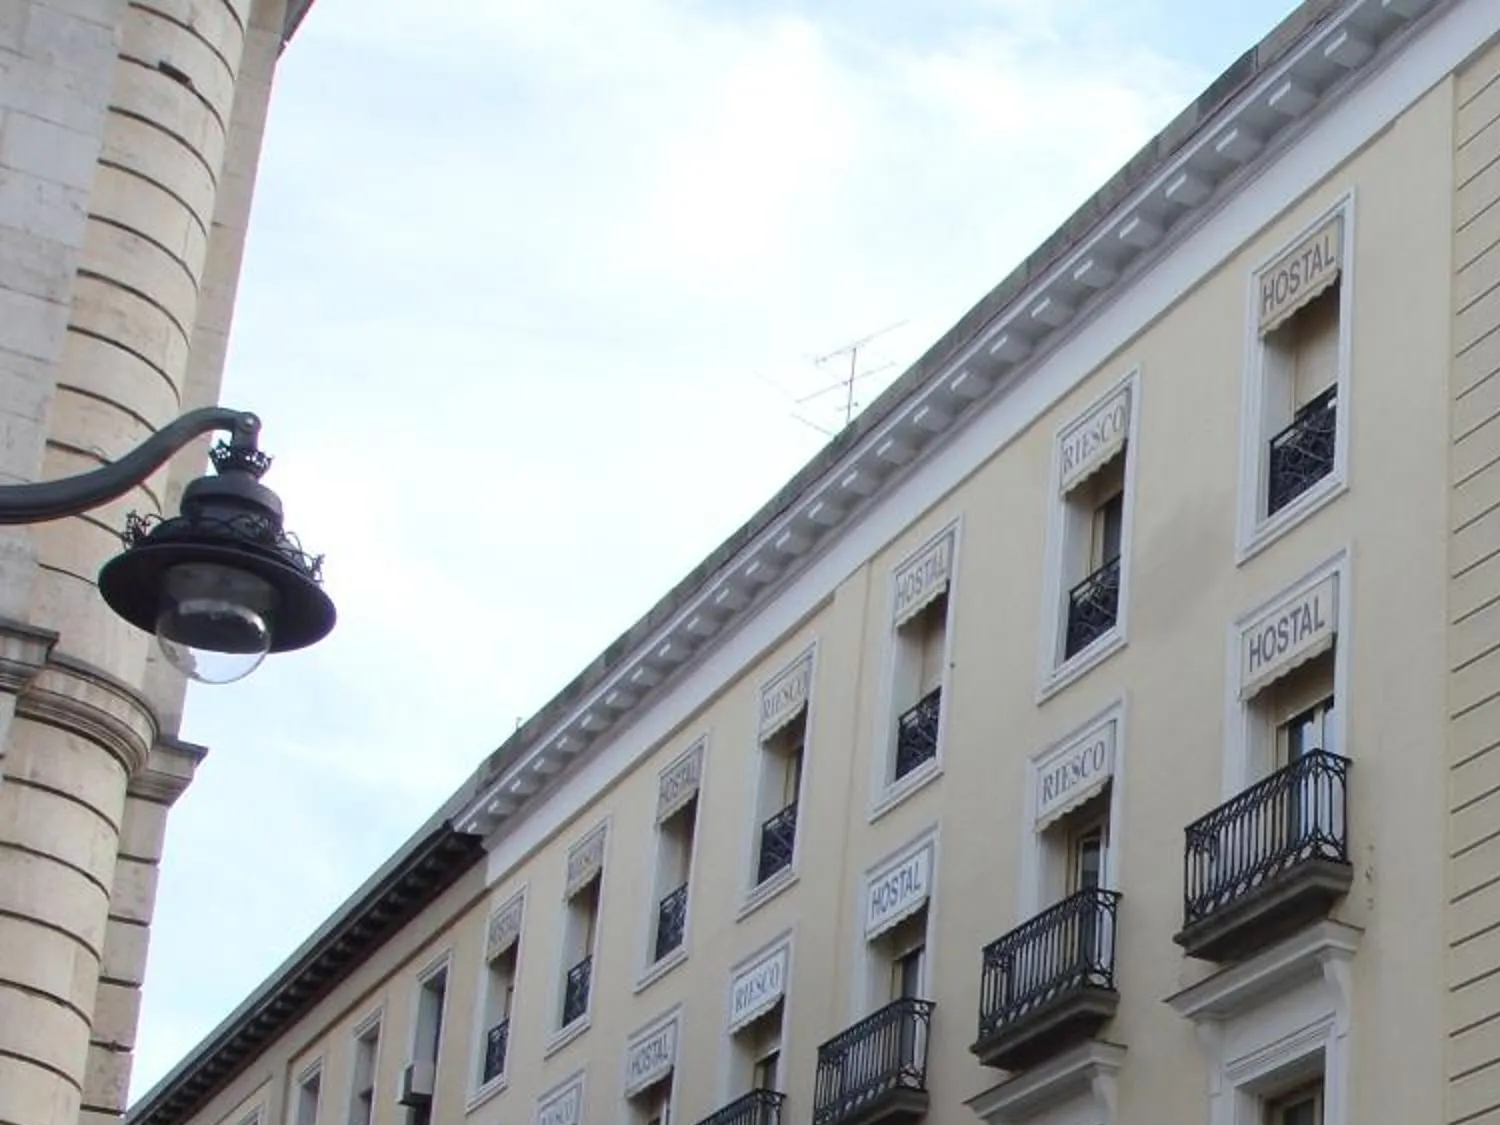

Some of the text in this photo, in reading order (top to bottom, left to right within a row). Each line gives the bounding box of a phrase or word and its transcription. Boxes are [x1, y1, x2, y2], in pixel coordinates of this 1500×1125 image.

[1263, 235, 1335, 308] HOSTAL
[1063, 404, 1127, 474] RIESCO
[897, 547, 946, 608] HOSTAL
[1249, 595, 1324, 674] HOSTAL
[1042, 740, 1106, 804] RIESCO
[872, 861, 921, 919] HOSTAL
[735, 960, 780, 1013] RIESCO
[631, 1030, 670, 1074] HOSTAL
